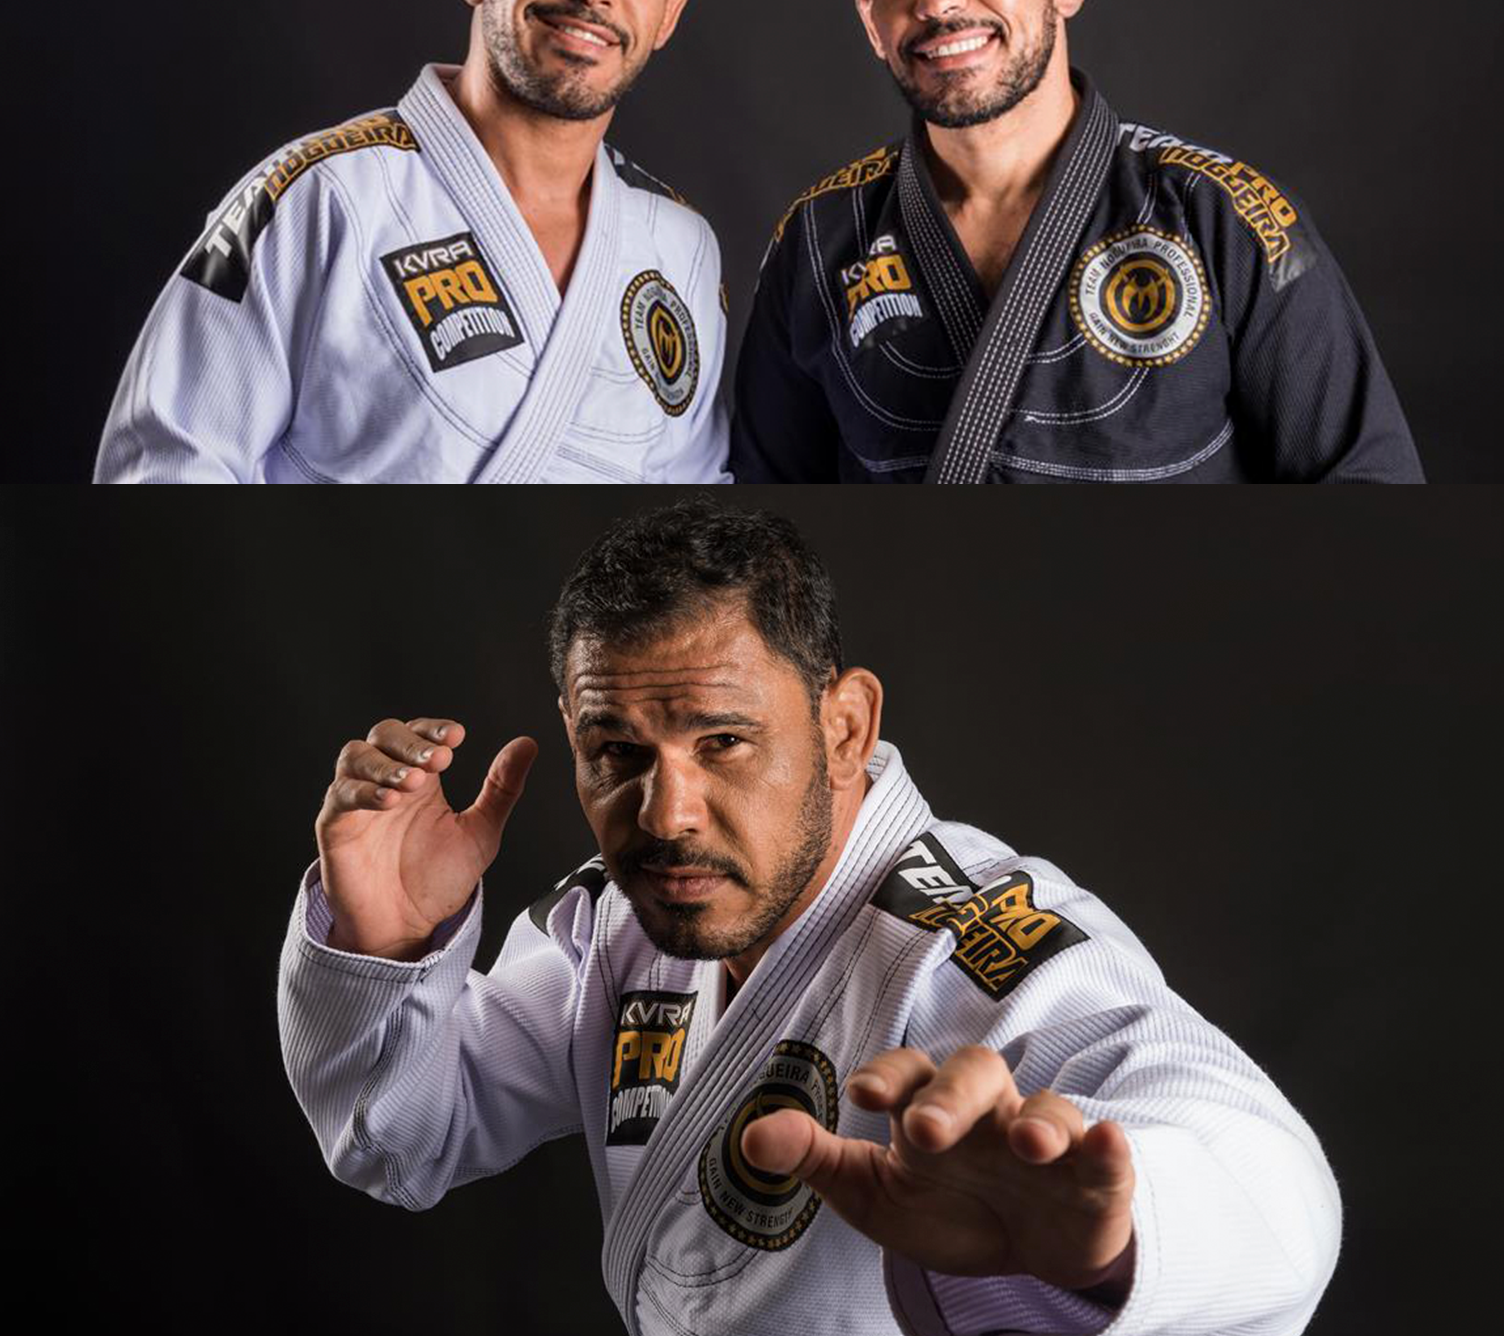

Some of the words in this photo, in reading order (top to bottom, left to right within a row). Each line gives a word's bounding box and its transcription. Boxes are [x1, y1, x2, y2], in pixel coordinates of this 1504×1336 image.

[264, 122, 416, 202] NOGUEIRA
[1158, 146, 1291, 264] NOGUEIRA
[393, 240, 474, 279] KVRA
[1085, 268, 1098, 295] TEAM
[1153, 240, 1198, 317] PROFESSIONAL
[403, 259, 498, 328] PRO
[849, 292, 923, 349] COMPETITION
[429, 305, 516, 361] COMPETITION
[1089, 312, 1108, 336] GAIN
[908, 893, 1030, 993] NEIRA
[620, 998, 693, 1026] KVRA
[612, 1027, 686, 1092] PRO
[760, 1063, 810, 1084] UEIRA
[610, 1084, 674, 1134] COMPET
[709, 1157, 722, 1190] GAIN
[720, 1190, 745, 1216] NEW
